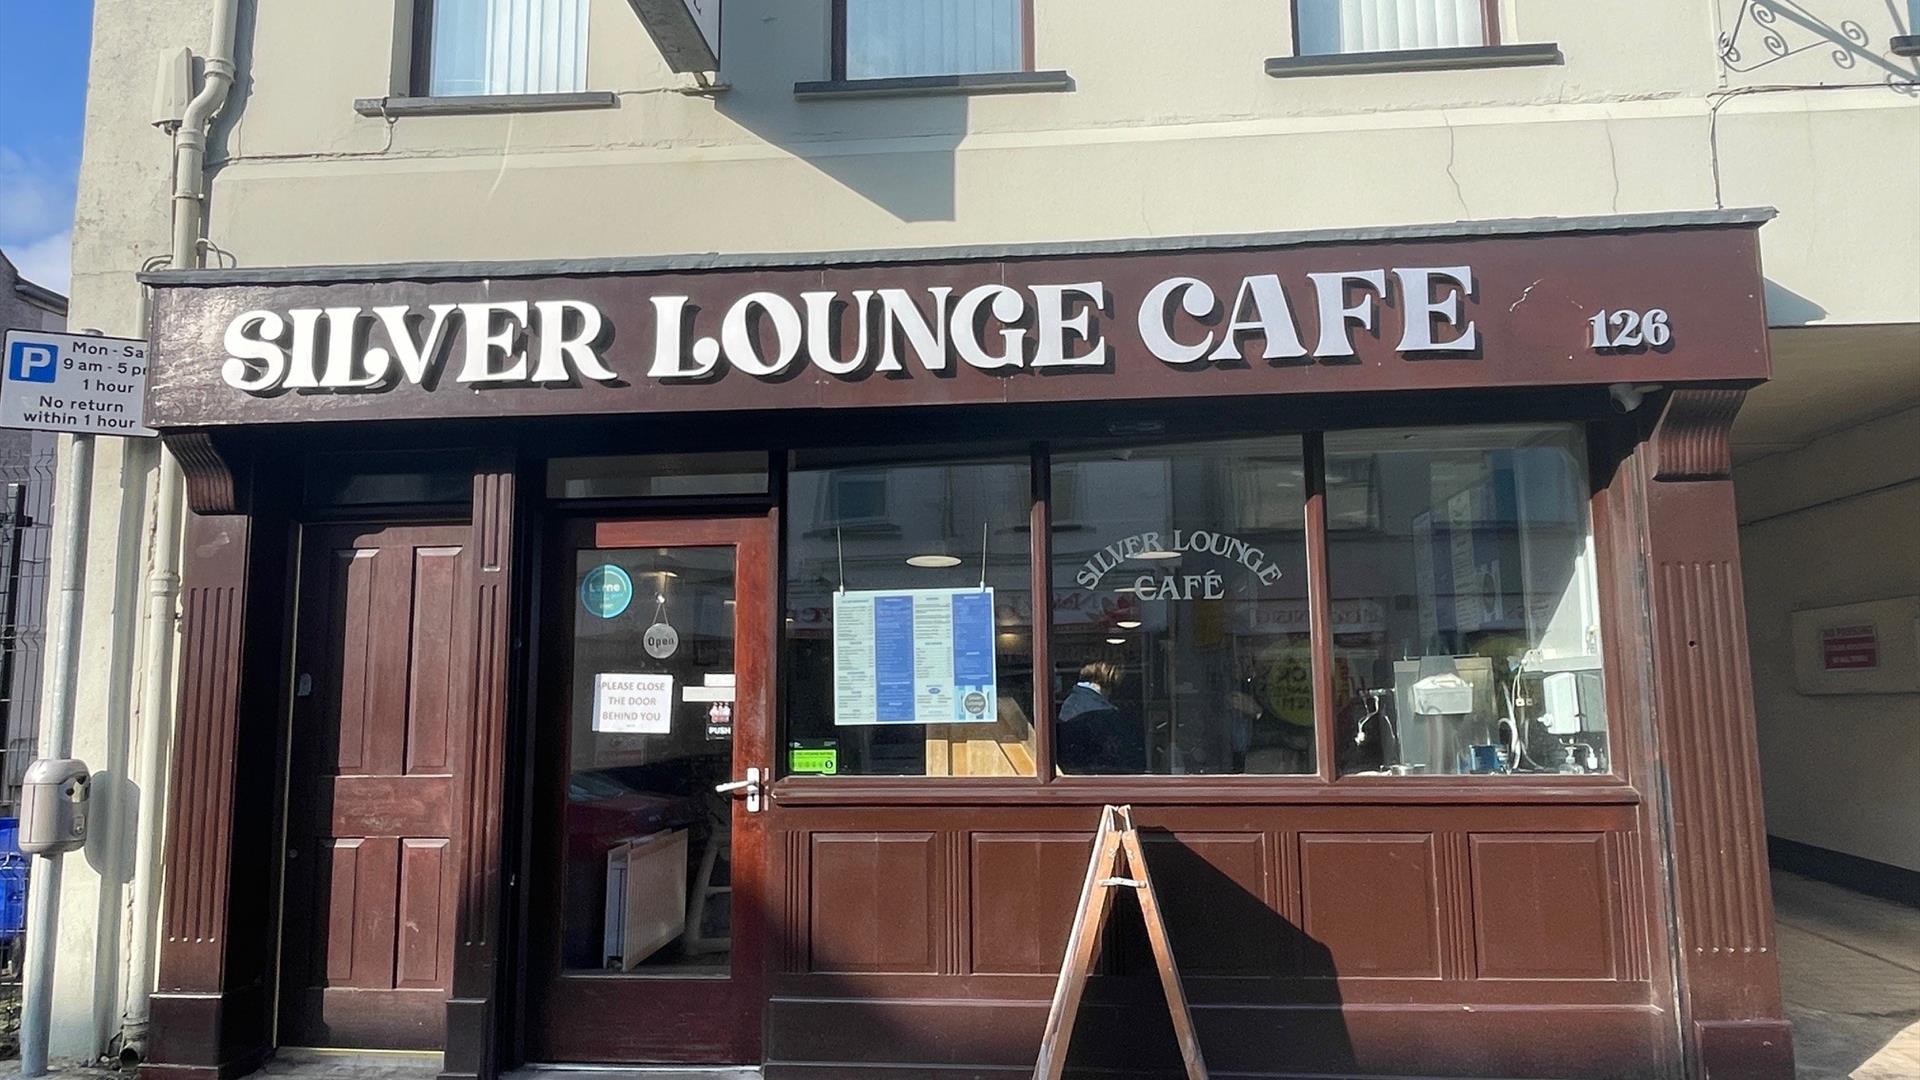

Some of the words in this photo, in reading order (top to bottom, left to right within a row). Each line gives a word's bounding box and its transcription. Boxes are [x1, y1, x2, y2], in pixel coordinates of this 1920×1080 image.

[222, 300, 617, 392] SILVER
[647, 281, 1107, 378] LOUNGE
[1137, 265, 1477, 364] CAFE
[1589, 308, 1671, 349] 126
[72, 341, 108, 355] Mon
[122, 345, 148, 358] Sa
[21, 346, 51, 378] P
[63, 357, 74, 370] 9
[78, 361, 102, 372] am
[117, 362, 128, 374] 5
[83, 378, 88, 390] 1
[96, 379, 134, 393] hour
[39, 395, 64, 409] No
[70, 398, 124, 413] return
[24, 411, 77, 425] within
[84, 414, 90, 426] 1
[97, 415, 136, 428] hour
[1076, 531, 1164, 591] SILVER
[1174, 529, 1283, 587] LOUNGE
[647, 636, 675, 649] Open
[601, 682, 634, 691] PLEASE
[636, 682, 665, 691] CLOSE
[608, 697, 626, 705] THE
[628, 697, 656, 705] DOOR
[602, 712, 638, 721] BEHIND
[640, 712, 661, 721] YOU
[708, 726, 731, 735] PUSH
